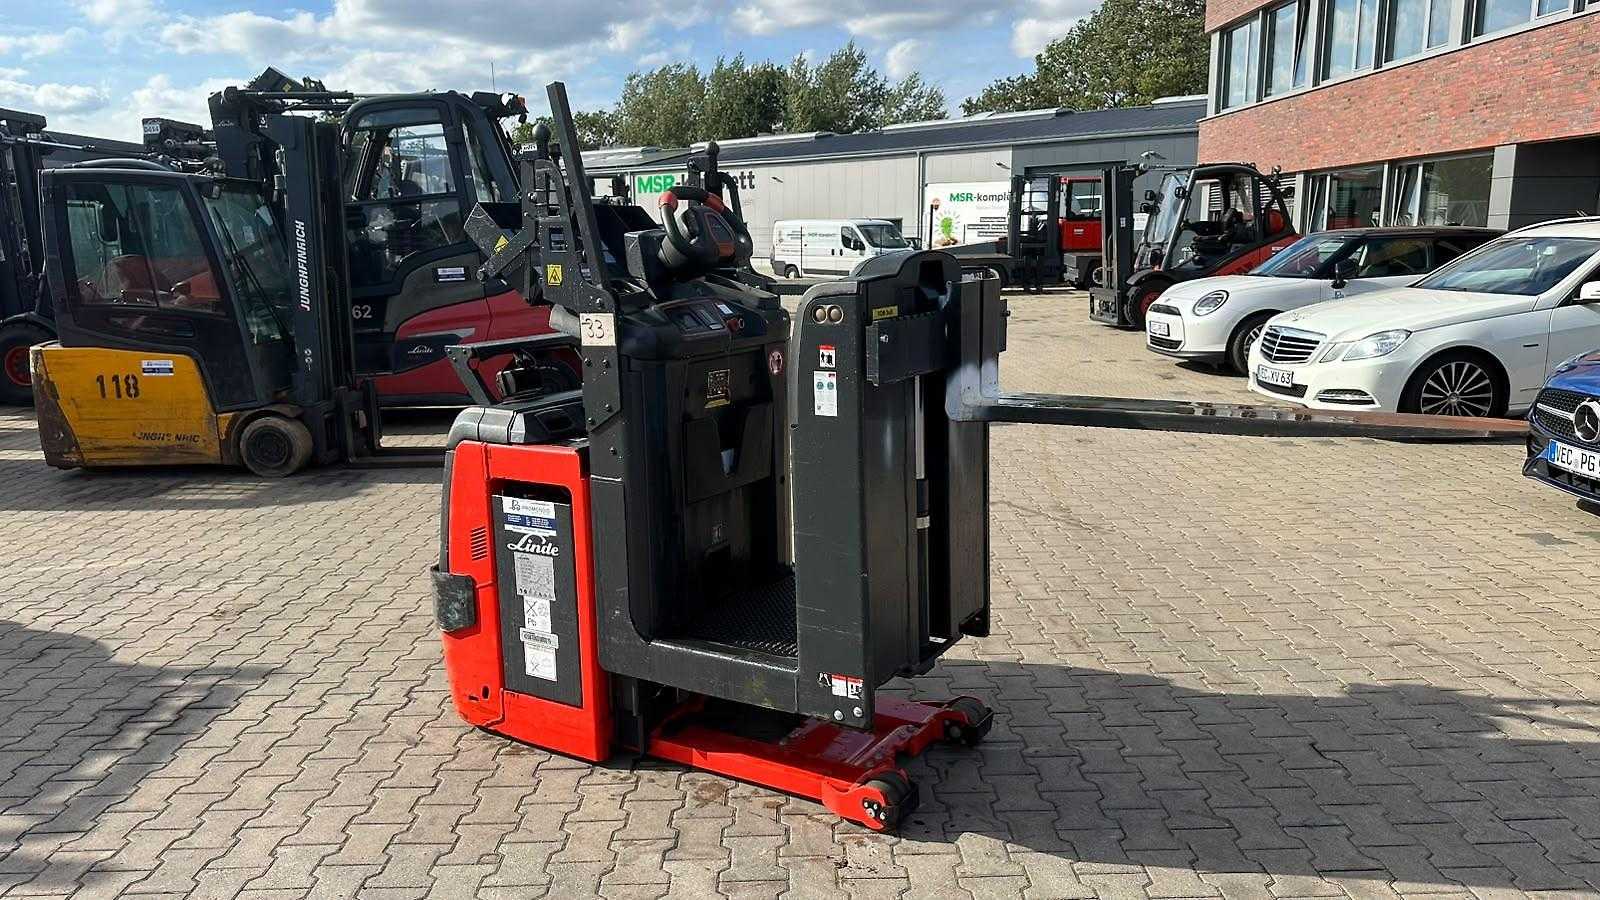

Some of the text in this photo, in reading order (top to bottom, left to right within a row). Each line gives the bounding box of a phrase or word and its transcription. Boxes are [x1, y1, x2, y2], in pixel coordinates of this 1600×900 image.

[352, 305, 372, 319] 62
[96, 373, 140, 399] 118
[1280, 372, 1291, 384] 63
[1556, 444, 1573, 465] VEC
[1580, 452, 1596, 473] PG
[507, 533, 559, 556] Linde
